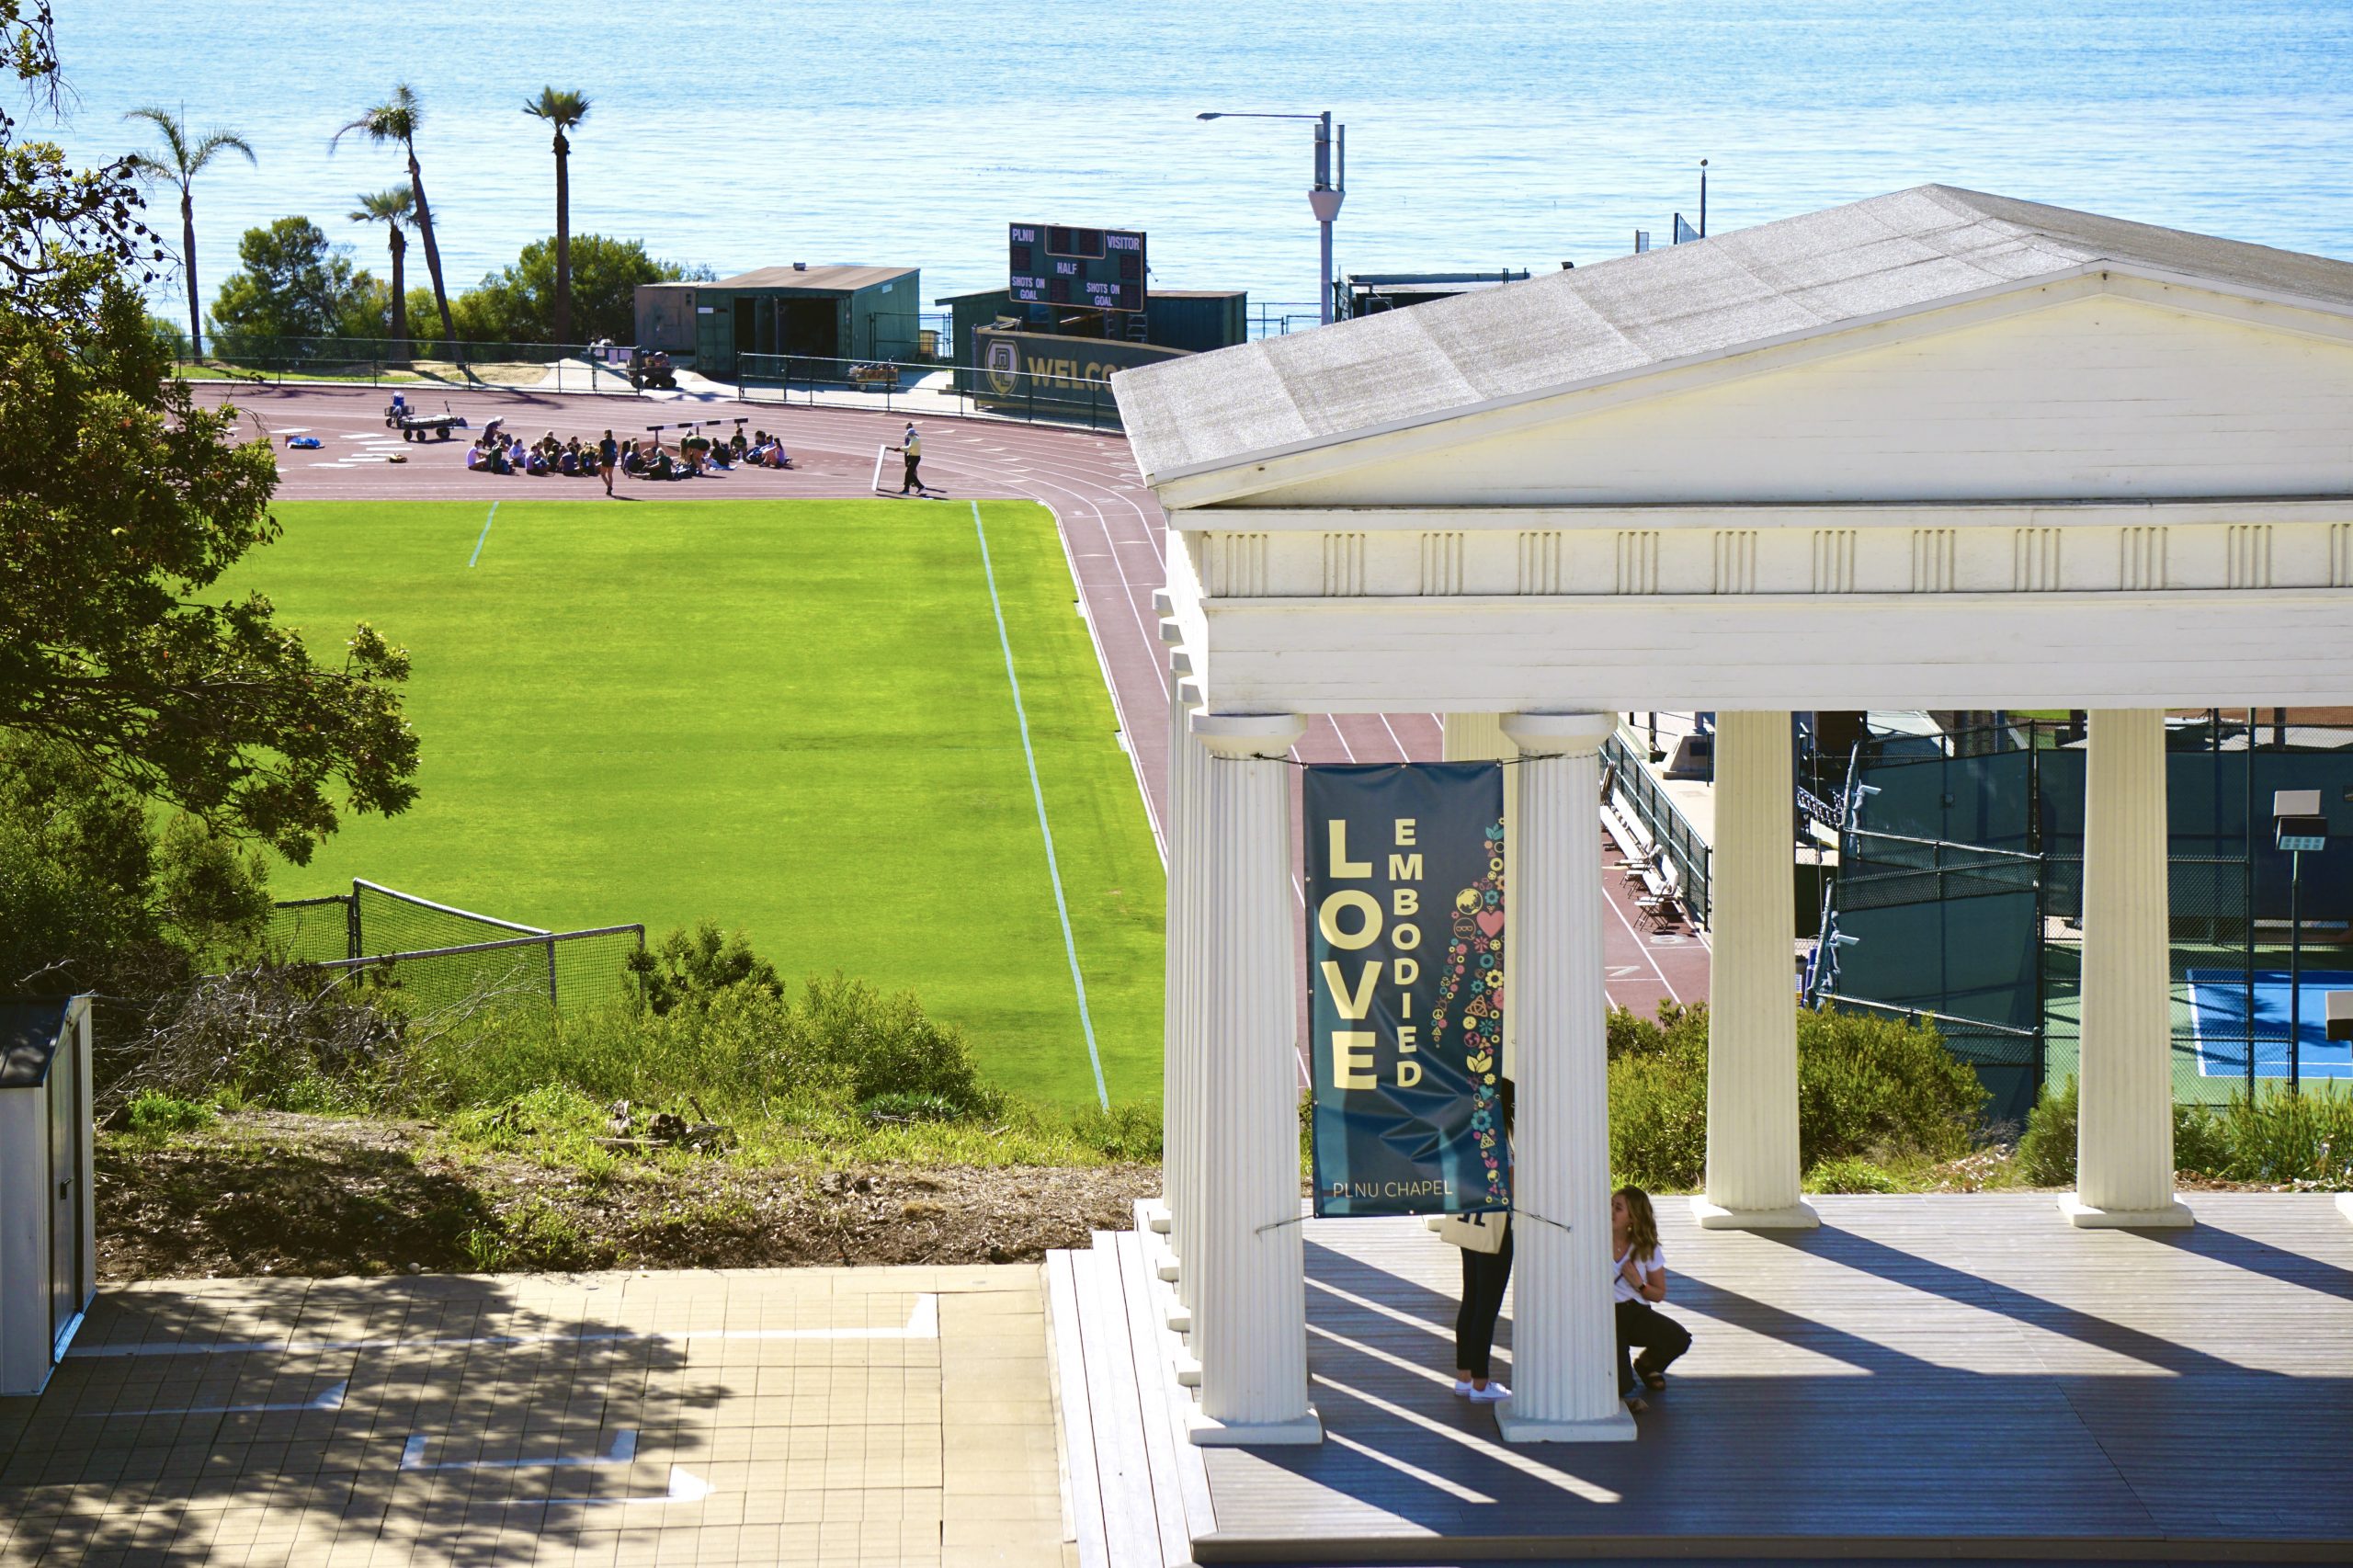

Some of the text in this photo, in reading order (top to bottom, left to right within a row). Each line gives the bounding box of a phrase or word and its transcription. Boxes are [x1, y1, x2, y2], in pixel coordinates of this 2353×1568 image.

[1012, 228, 1035, 243] PLNU
[1107, 235, 1141, 251] VISITOR
[1057, 262, 1077, 275] HALF
[1012, 276, 1046, 289] SHOTS ON
[1086, 282, 1120, 295] SHOTS ON
[1019, 290, 1038, 301] GOAL
[1094, 295, 1113, 307] GOAL
[1319, 819, 1383, 1090] LOVE
[1389, 818, 1423, 1088] EMBODIED
[1334, 1179, 1453, 1199] PLNU CHAPEL
